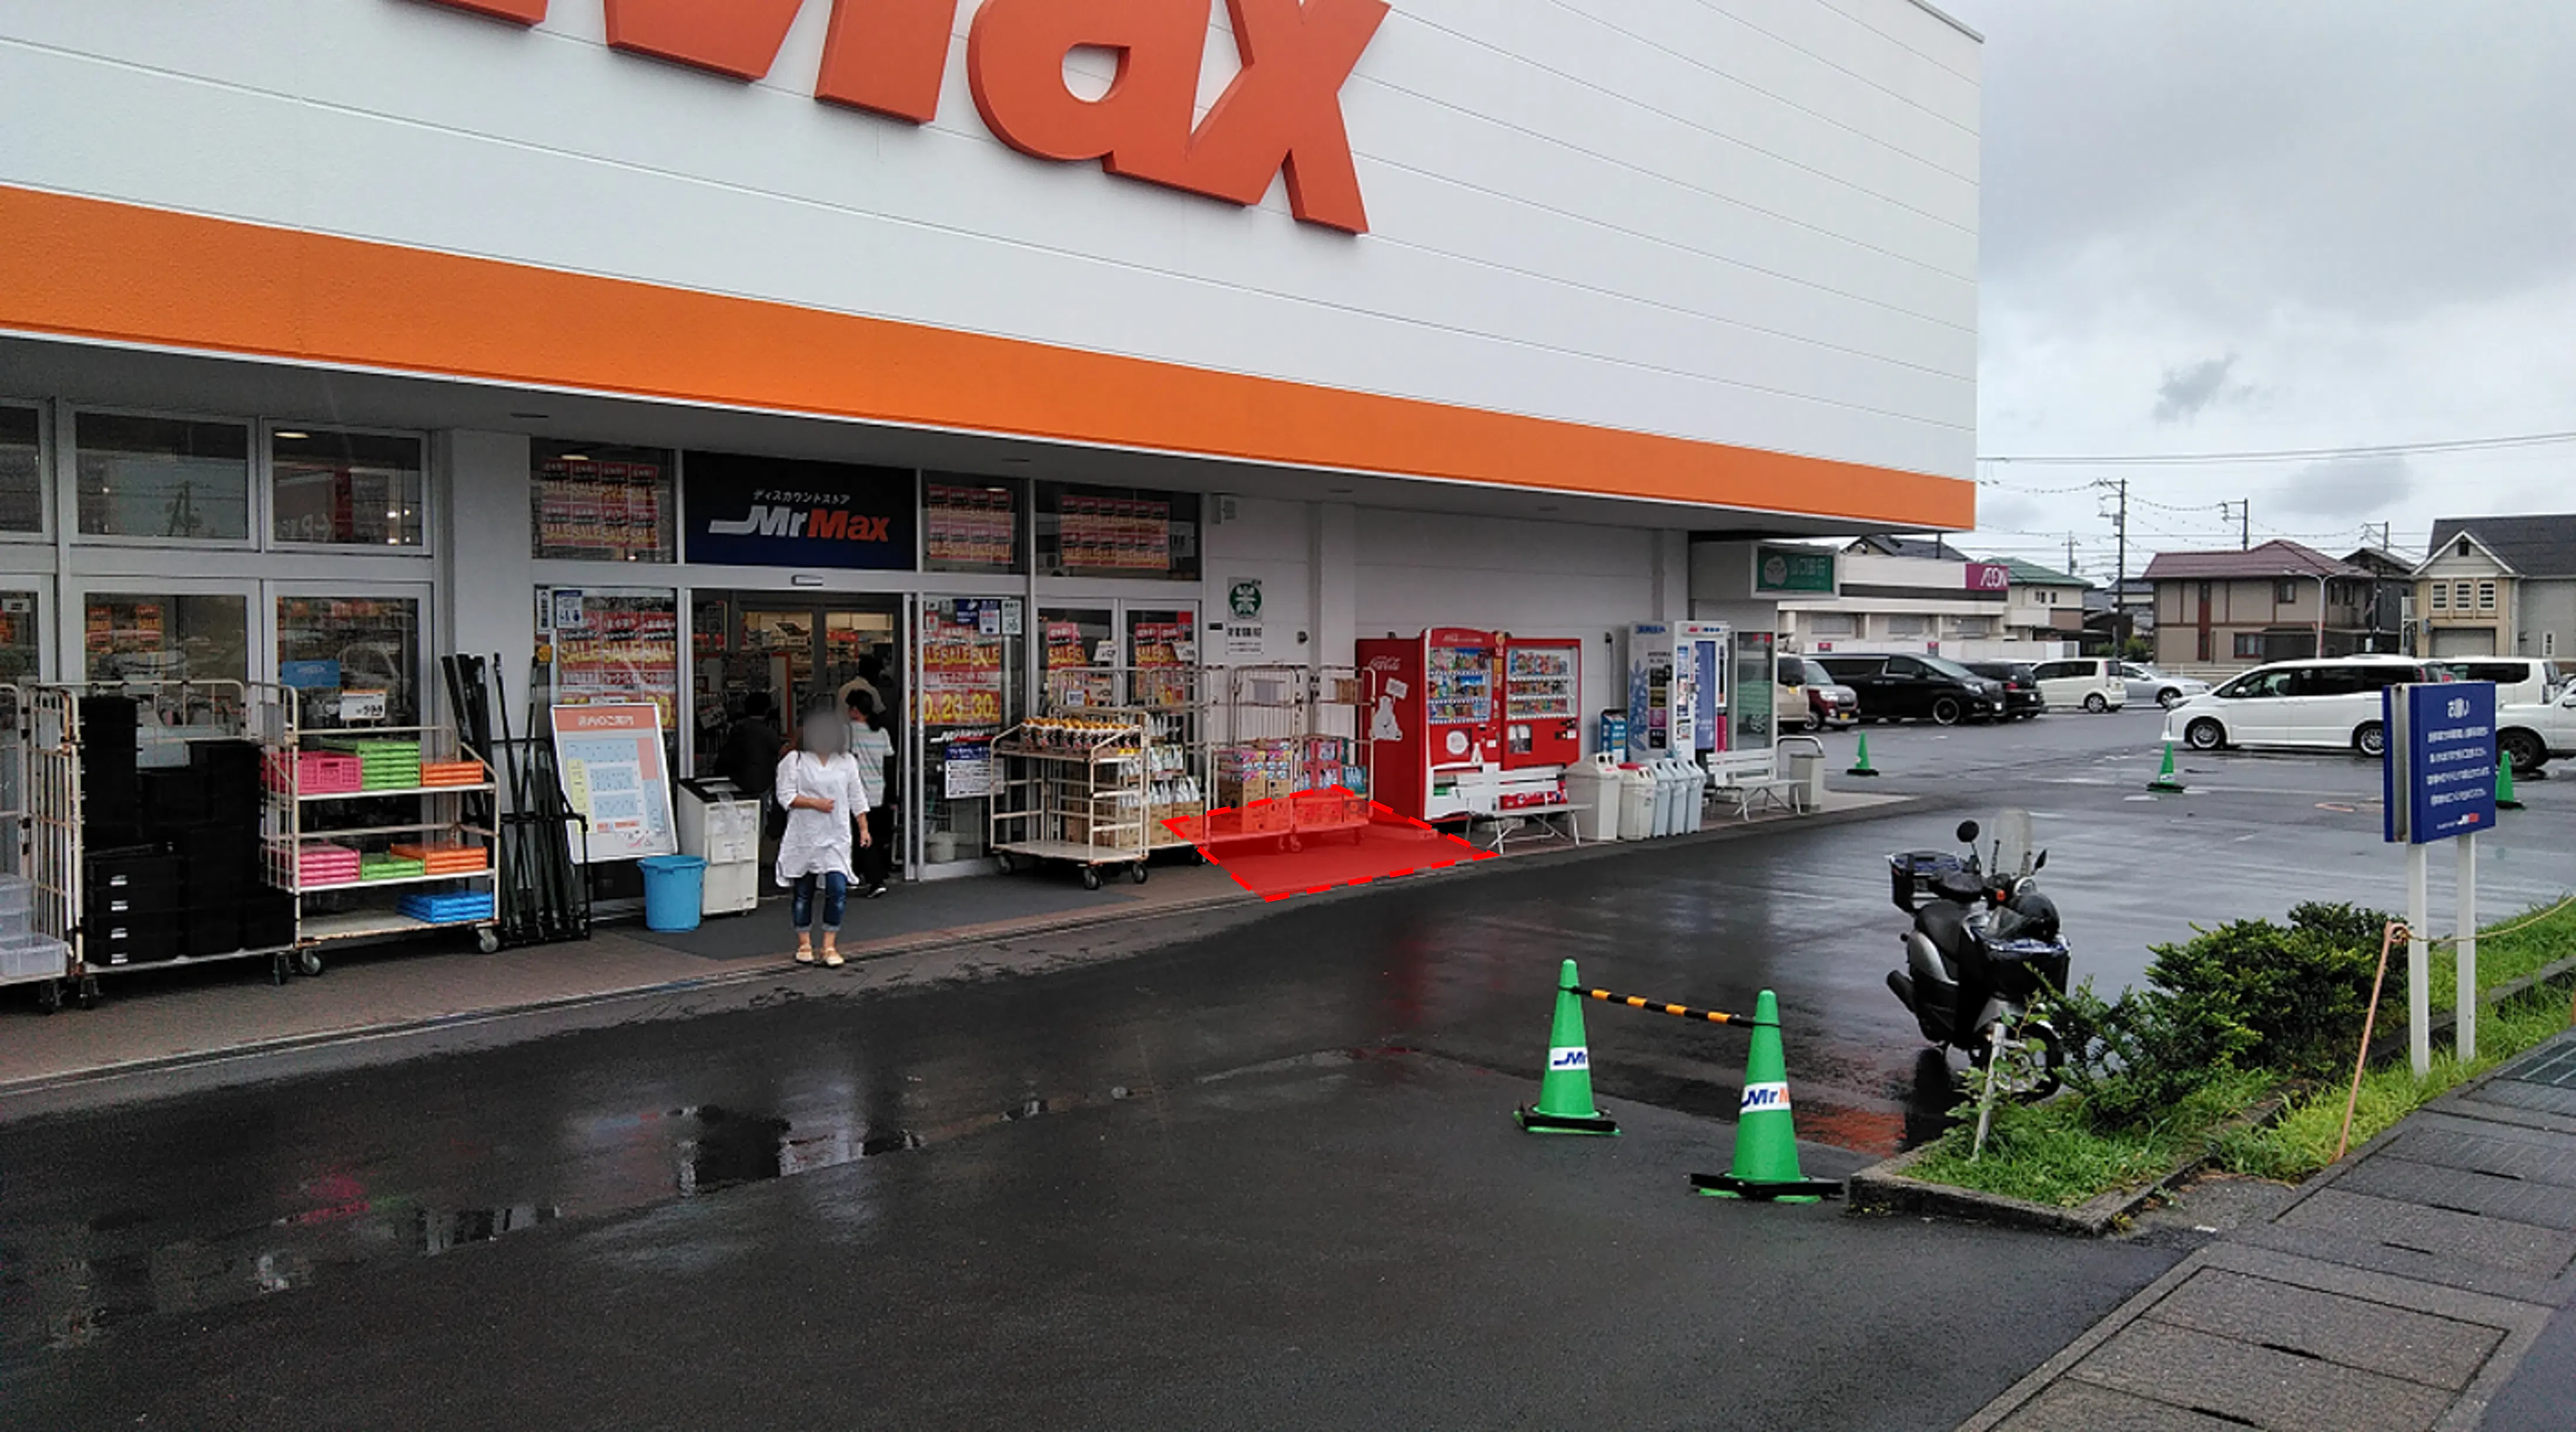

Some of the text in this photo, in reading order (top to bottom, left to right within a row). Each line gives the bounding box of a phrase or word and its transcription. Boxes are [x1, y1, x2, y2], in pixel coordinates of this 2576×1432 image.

[753, 489, 850, 505] ディスカウントストア
